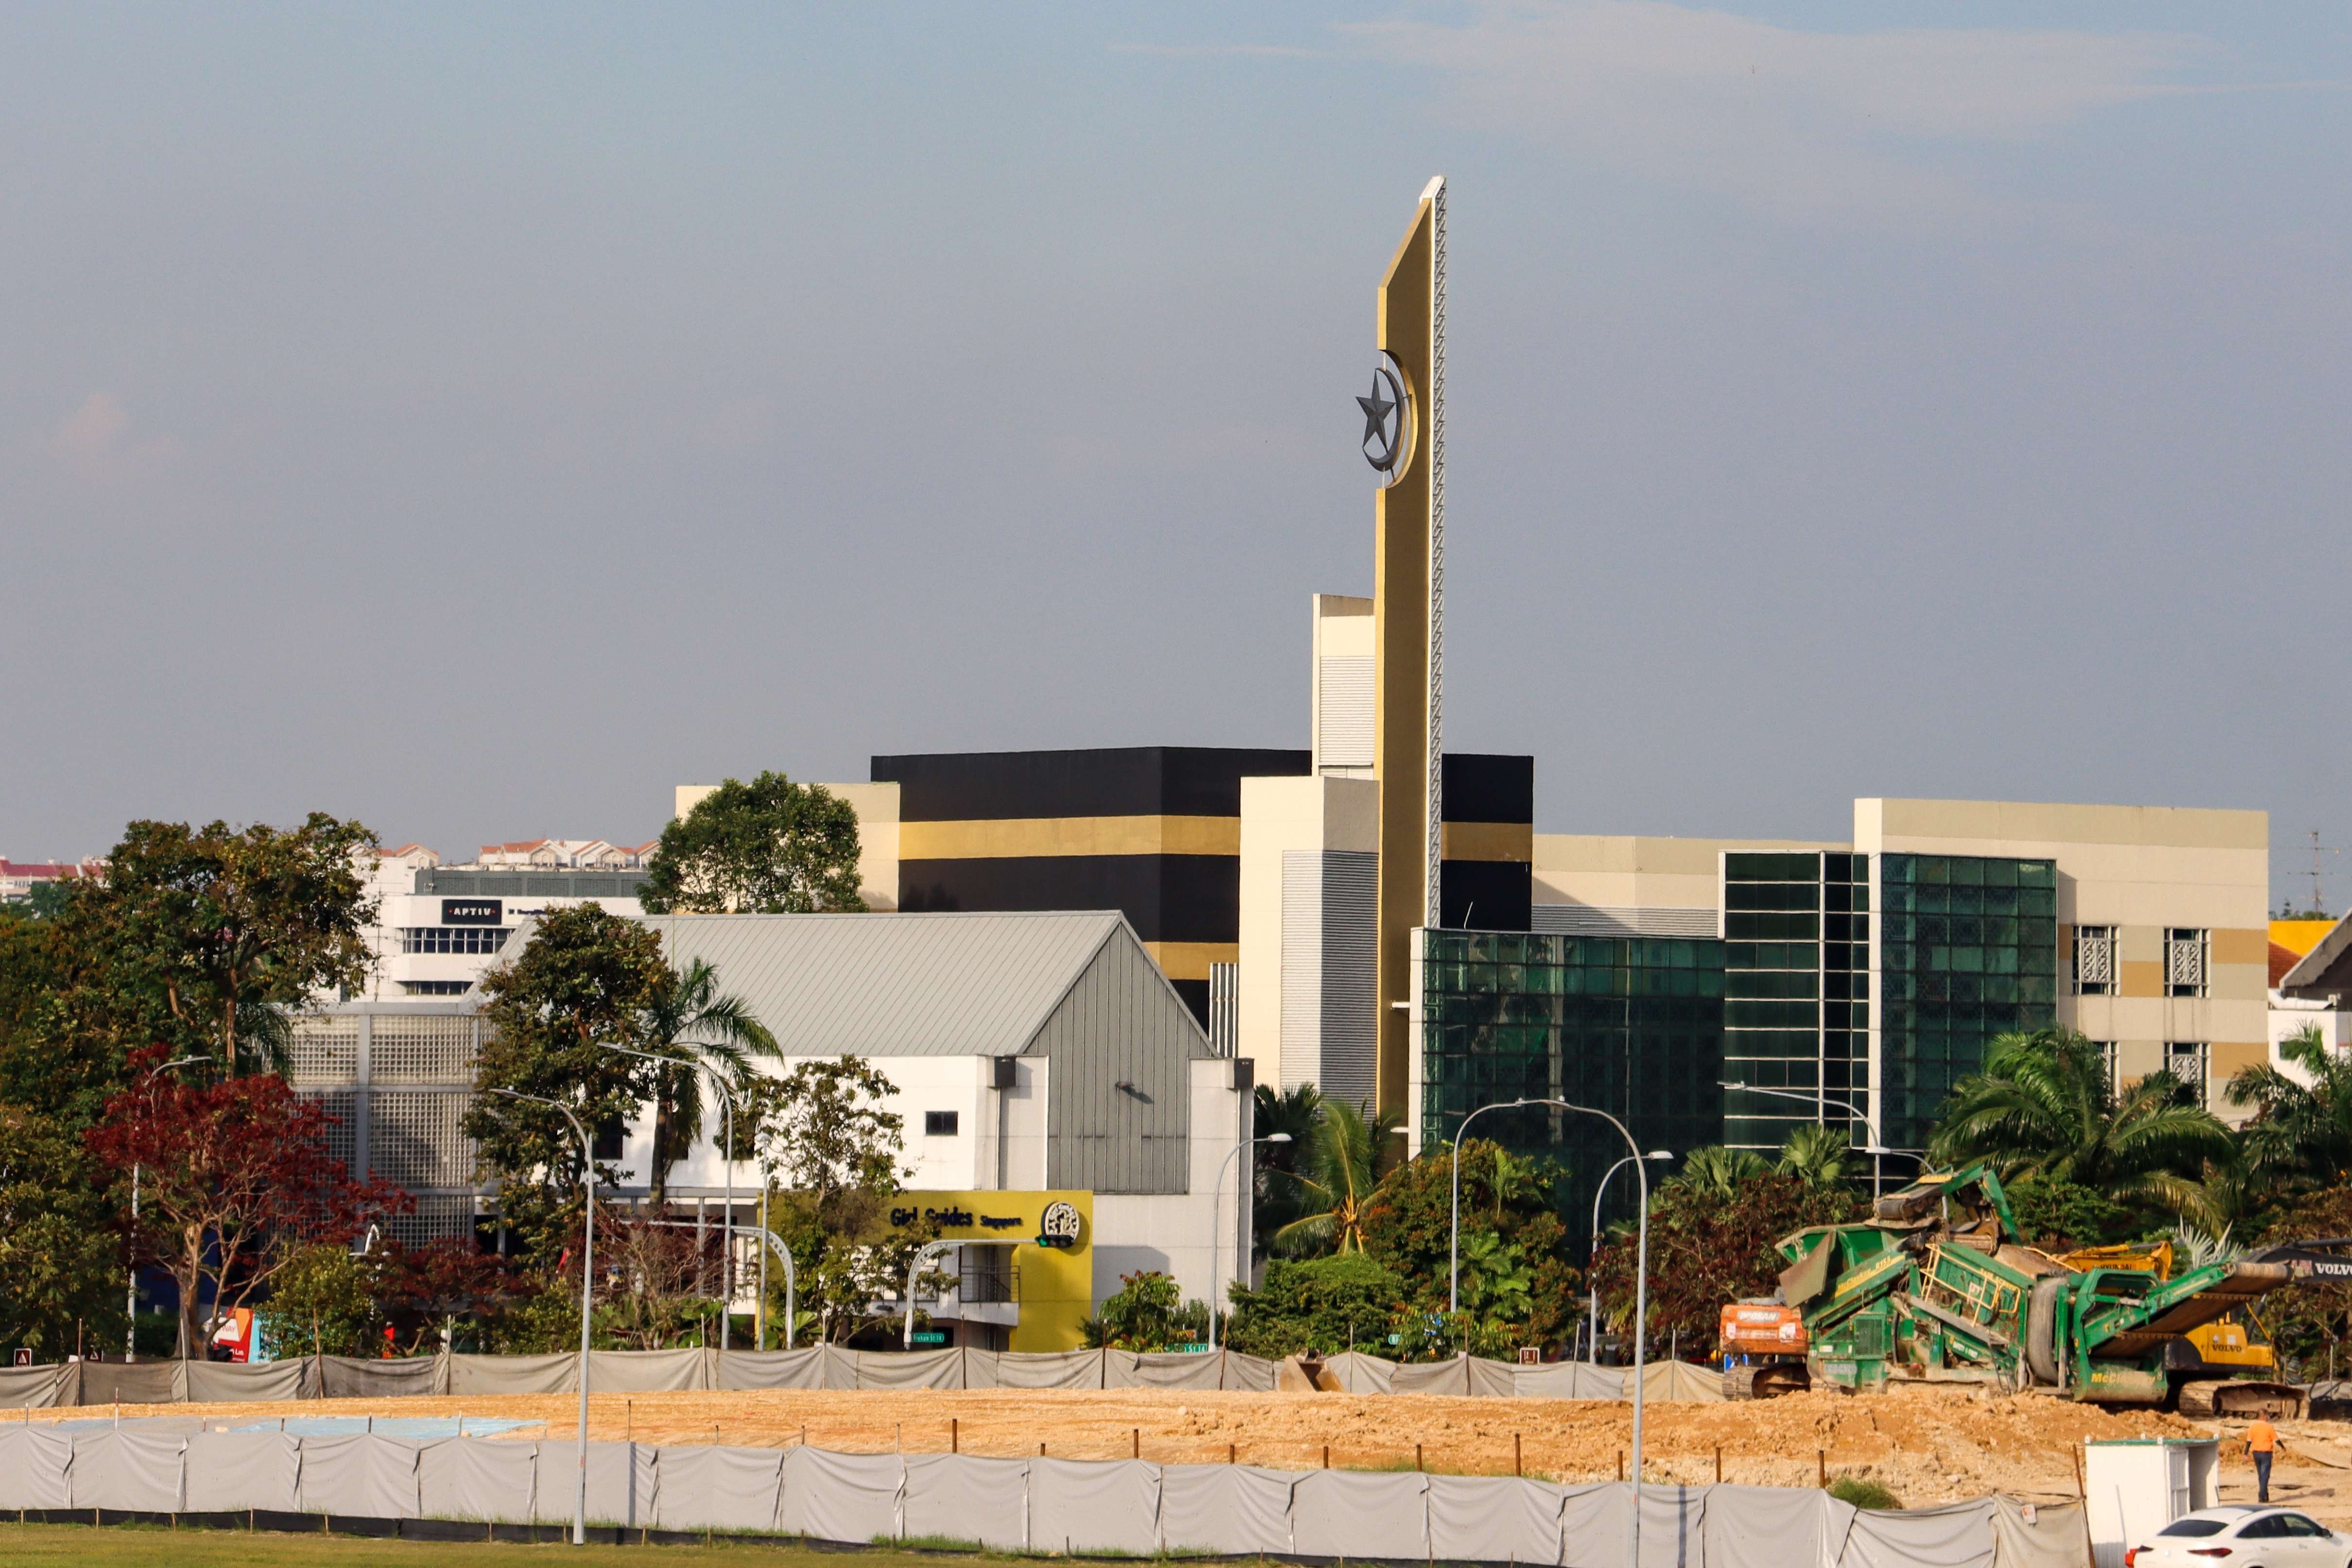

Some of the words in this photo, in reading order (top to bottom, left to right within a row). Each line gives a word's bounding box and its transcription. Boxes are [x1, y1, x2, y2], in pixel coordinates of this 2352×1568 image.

[454, 907, 491, 916] APTIV
[890, 1206, 918, 1227] Girl
[925, 1206, 973, 1227] Guides
